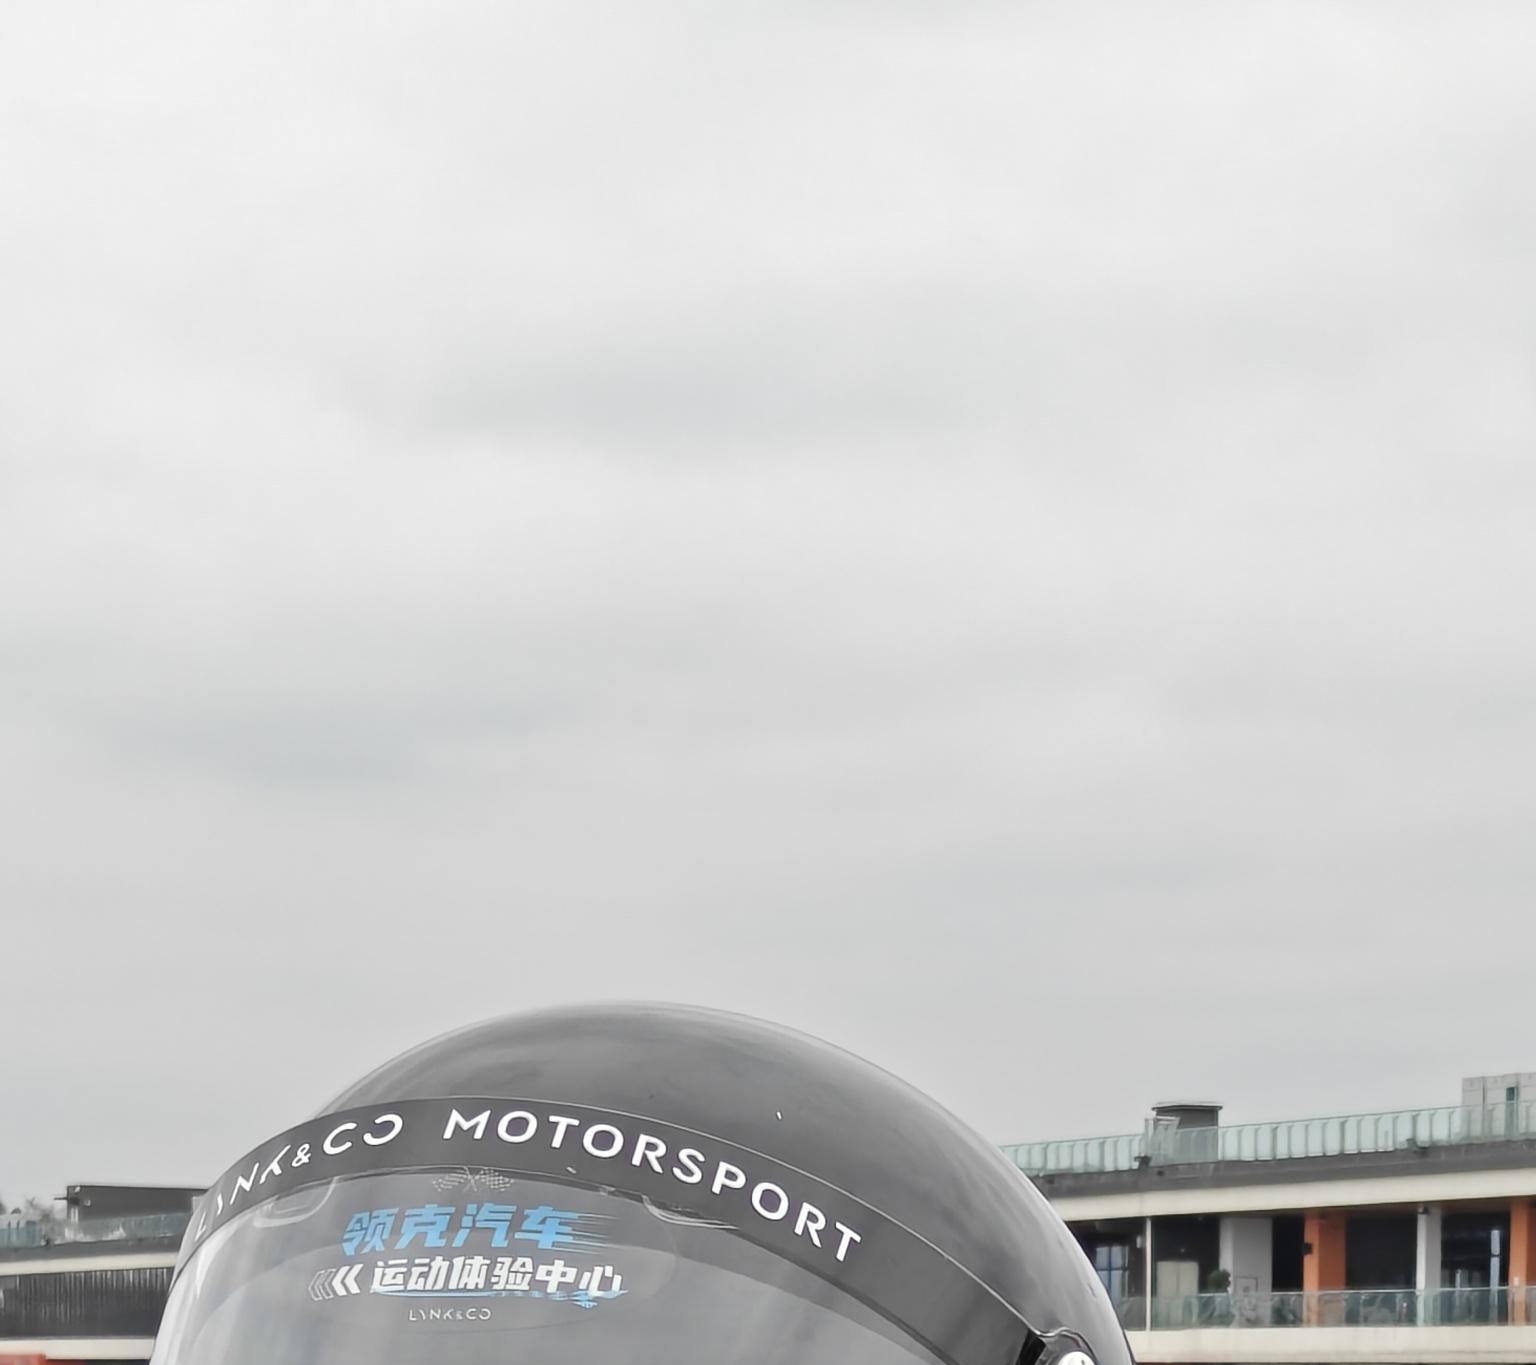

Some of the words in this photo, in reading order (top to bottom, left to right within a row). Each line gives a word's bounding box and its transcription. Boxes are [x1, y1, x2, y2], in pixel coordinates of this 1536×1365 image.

[442, 1108, 862, 1263] MOTORSPORT
[341, 1202, 580, 1256] 领克汽车
[369, 1255, 622, 1297] 运动体验中心
